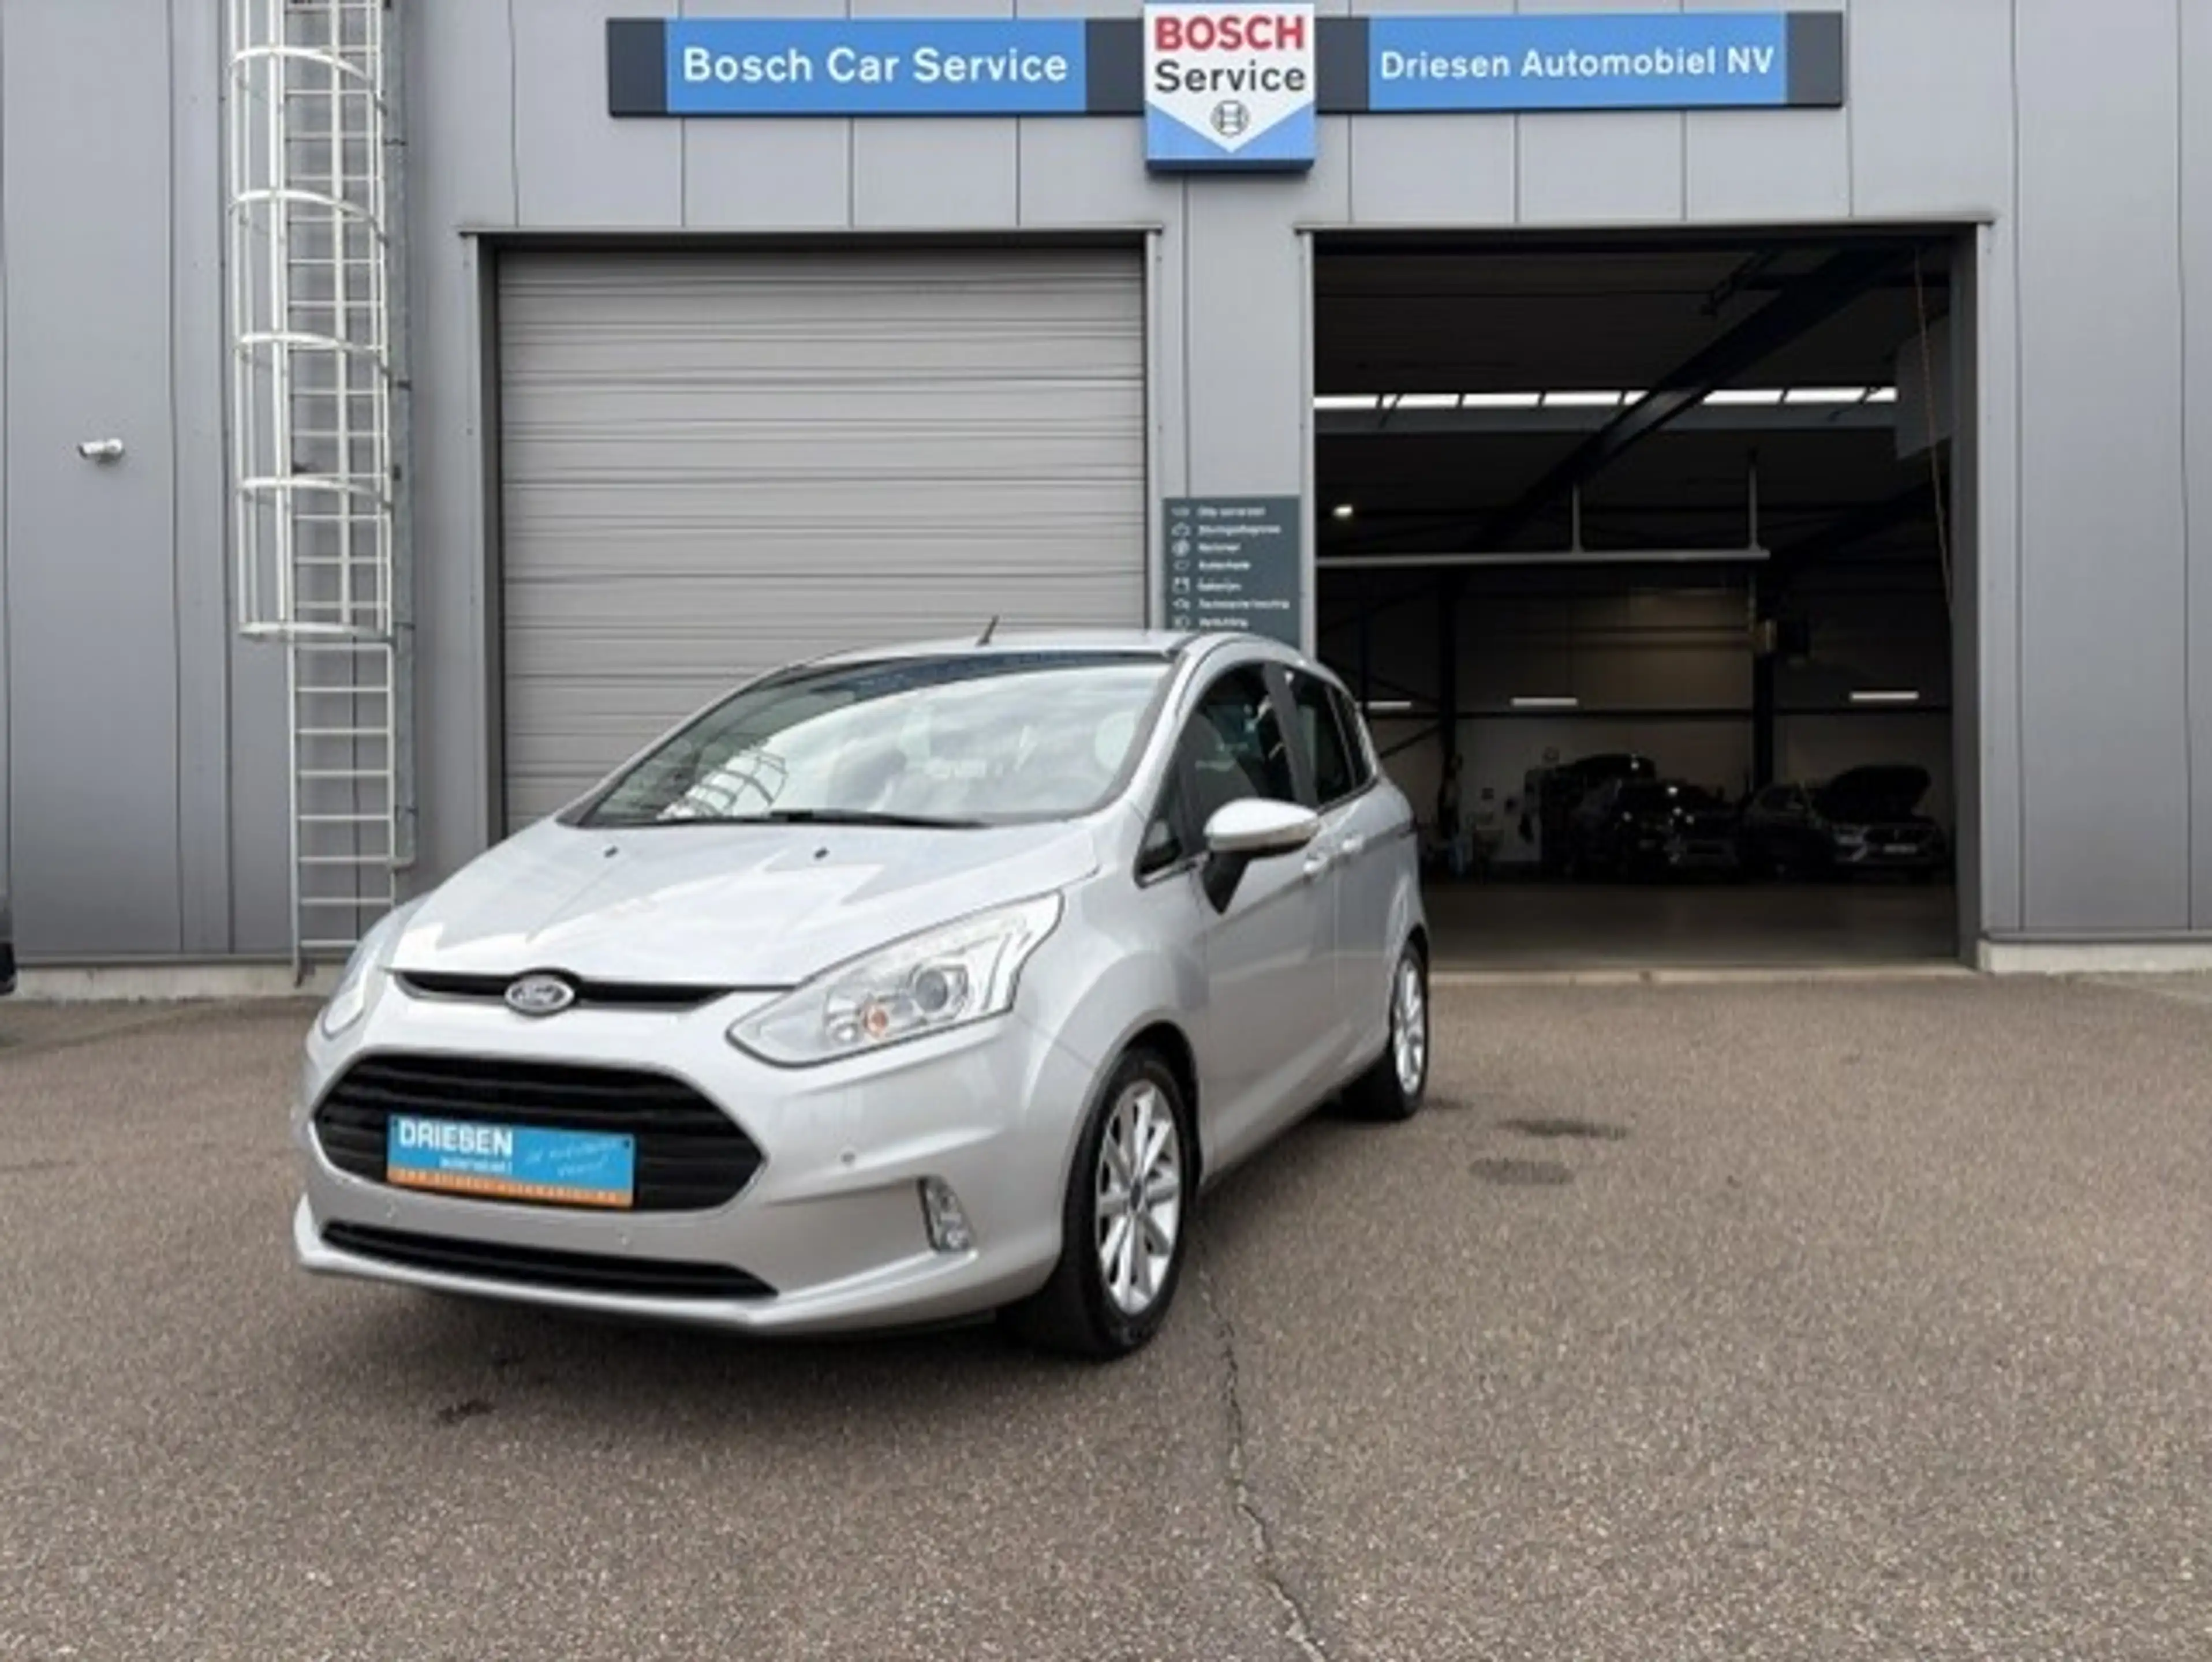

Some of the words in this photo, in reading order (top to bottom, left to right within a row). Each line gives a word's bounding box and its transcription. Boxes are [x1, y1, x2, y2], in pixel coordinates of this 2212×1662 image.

[1154, 16, 1305, 50] BOSCH
[683, 47, 812, 82] Bosch
[827, 47, 899, 82] Car
[913, 47, 1067, 83] Service
[1155, 59, 1306, 93] Service
[1381, 50, 1511, 80] Driesen
[1520, 47, 1716, 78] Automobiel
[1727, 46, 1774, 75] NV
